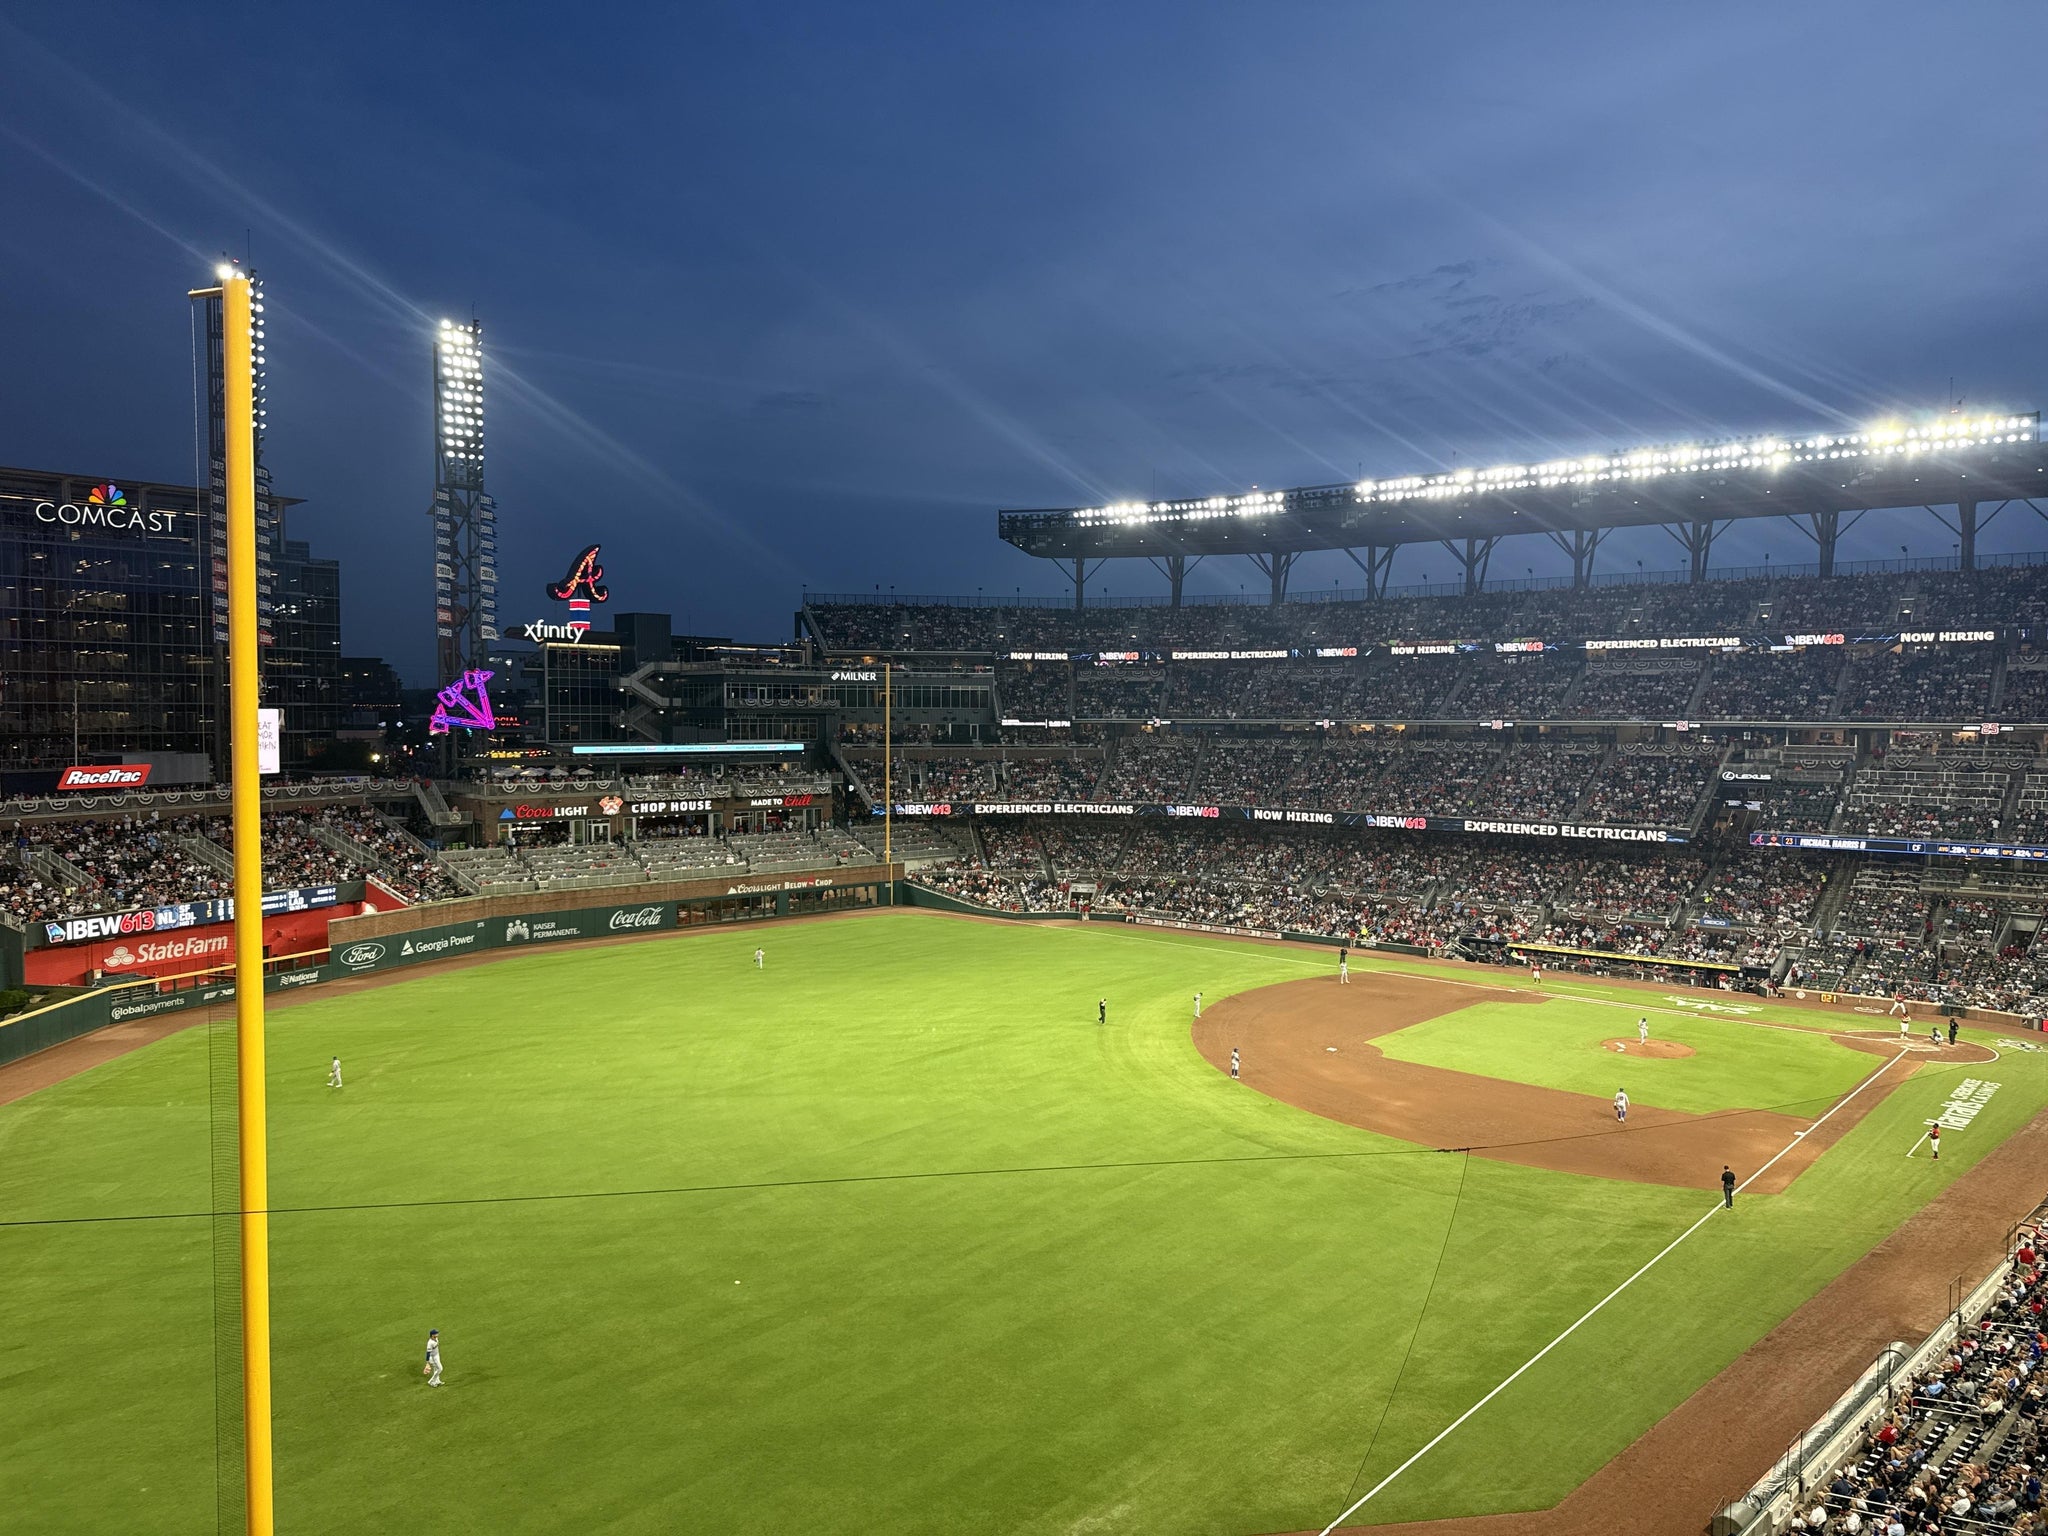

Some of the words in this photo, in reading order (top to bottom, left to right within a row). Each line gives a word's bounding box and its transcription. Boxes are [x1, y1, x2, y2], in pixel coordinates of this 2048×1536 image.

[36, 502, 177, 532] COMCAST
[523, 619, 585, 643] xfinity
[1900, 633, 1934, 643] NOW
[1937, 630, 1995, 642] HIRING
[1391, 646, 1416, 655] NOW
[1418, 645, 1456, 654] HIRING
[1585, 640, 1658, 650] EXPERIENCED
[1660, 637, 1741, 648] ELECTRICIANS
[1010, 652, 1032, 660] NOW
[1034, 652, 1068, 660] HIRING
[1172, 651, 1229, 660] EXPERIENCED
[1231, 650, 1288, 659] ELECTRICIANS
[840, 672, 877, 681] MILNER
[1981, 723, 2000, 734] 25
[66, 769, 143, 785] RaceTrac
[631, 802, 667, 814] CHOP
[670, 800, 712, 812] HOUSE
[750, 799, 772, 807] MADE
[784, 794, 814, 807] Chill
[515, 804, 554, 819] Coors
[554, 806, 589, 817] LIGHT
[905, 804, 951, 816] IBEW613
[974, 804, 1052, 815] EXPERIENCED
[1054, 804, 1135, 815] ELECTRICIANS
[1176, 805, 1219, 818] IBEW613
[1254, 809, 1283, 821] NOW
[1286, 811, 1334, 824] HIRING
[1376, 816, 1427, 830] IBEW613
[1464, 820, 1557, 836] EXPERIENCED
[1561, 825, 1668, 843] ELECTRICIANS
[1799, 838, 1831, 848] MICHAEL
[1831, 840, 1859, 849] HARRIS
[737, 884, 760, 894] Coors
[760, 883, 781, 891] LIGHT
[179, 904, 190, 913] SF
[156, 911, 177, 925] NL
[180, 911, 196, 922] COL
[609, 906, 664, 929] Coca-Cola
[66, 911, 155, 941] IBEW613
[533, 922, 556, 932] KAISER
[415, 939, 449, 953] Georgia
[450, 934, 475, 948] Power
[348, 946, 378, 963] Ford
[287, 971, 318, 984] National
[111, 998, 185, 1019] globalpayments
